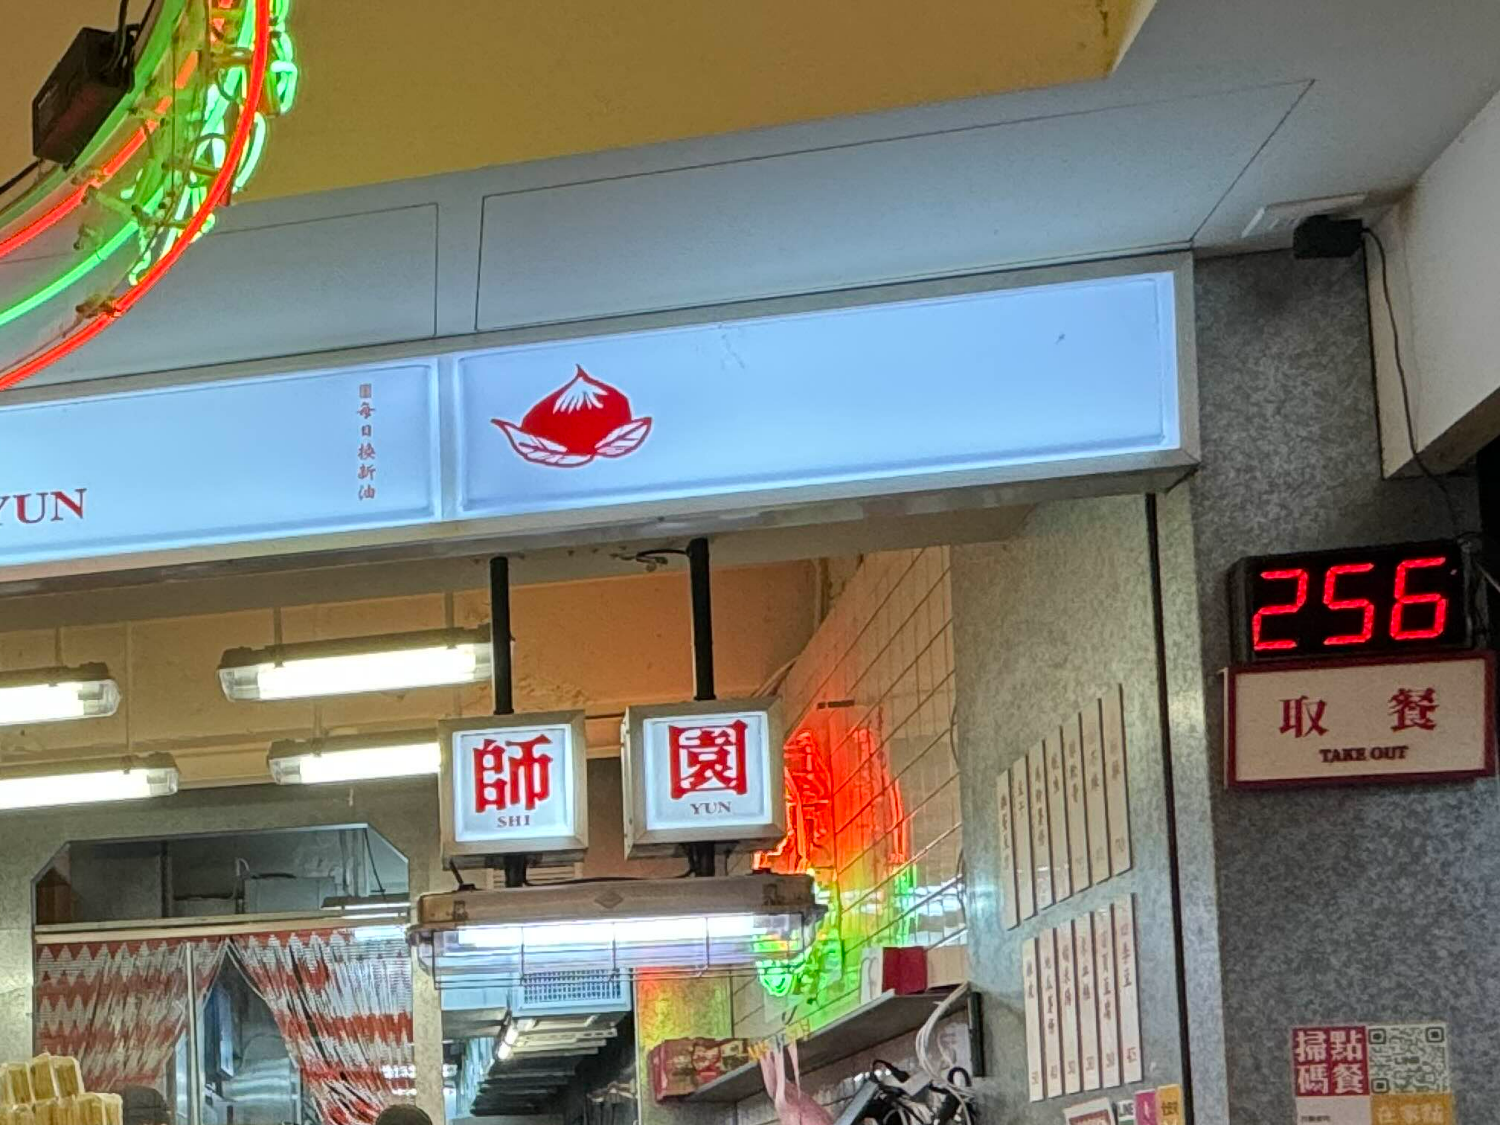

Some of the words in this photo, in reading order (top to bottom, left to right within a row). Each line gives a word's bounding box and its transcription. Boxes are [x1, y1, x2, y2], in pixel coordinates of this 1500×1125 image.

[357, 401, 376, 501] 每日換新油
[1252, 556, 1448, 652] 256
[1278, 686, 1439, 738] 取餐
[472, 734, 554, 813] 師
[668, 719, 748, 799] 園
[1319, 747, 1367, 764] TAKE
[1370, 745, 1409, 760] OUT
[497, 815, 531, 828] SHI
[690, 801, 732, 815] YUN
